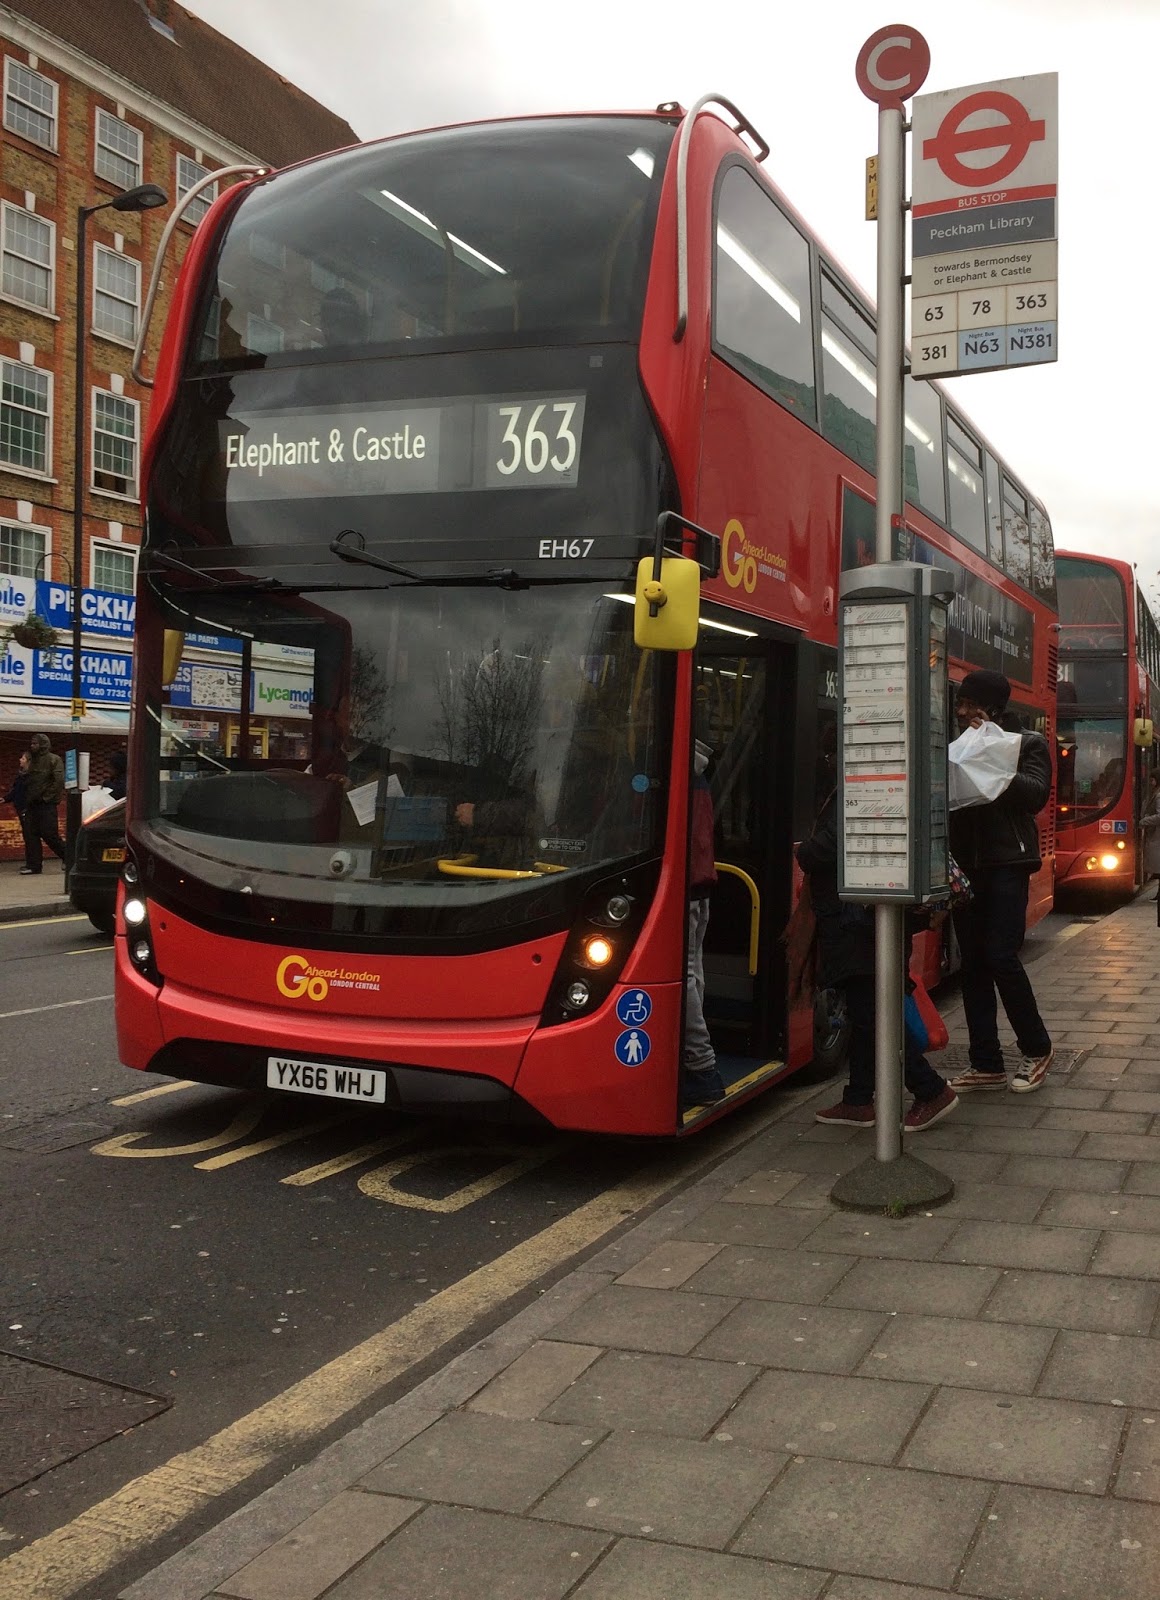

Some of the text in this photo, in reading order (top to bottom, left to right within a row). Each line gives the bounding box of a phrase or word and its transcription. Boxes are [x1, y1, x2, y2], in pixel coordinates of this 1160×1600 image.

[866, 36, 911, 91] C
[958, 192, 1007, 208] BUS STOP
[930, 216, 1034, 240] Peckham Library
[933, 254, 1032, 274] towards Bermondsey
[946, 271, 987, 284] Elephant
[990, 269, 998, 278] &
[1000, 266, 1032, 277] Castle
[972, 300, 992, 315] 78
[1015, 294, 1048, 311] 363
[924, 306, 944, 322] 63
[968, 332, 984, 340] Night
[1017, 327, 1033, 335] Night
[964, 338, 1000, 356] N63
[1010, 333, 1053, 351] N381
[921, 345, 947, 361] 381
[496, 402, 577, 475] 363
[225, 425, 426, 477] Elephant & Castle
[538, 538, 595, 559] EH67
[722, 518, 757, 593] Go
[198, 635, 219, 645] PARTS
[87, 675, 96, 684] IN
[97, 676, 112, 685] ALL
[89, 687, 105, 696] 020
[106, 688, 126, 698] 7732
[73, 700, 85, 715] H
[845, 799, 858, 807] 363
[276, 954, 381, 1001] Go Ahead-London
[330, 979, 380, 991] LONDON CENTRAL
[276, 1062, 376, 1096] YX66 WHJ
